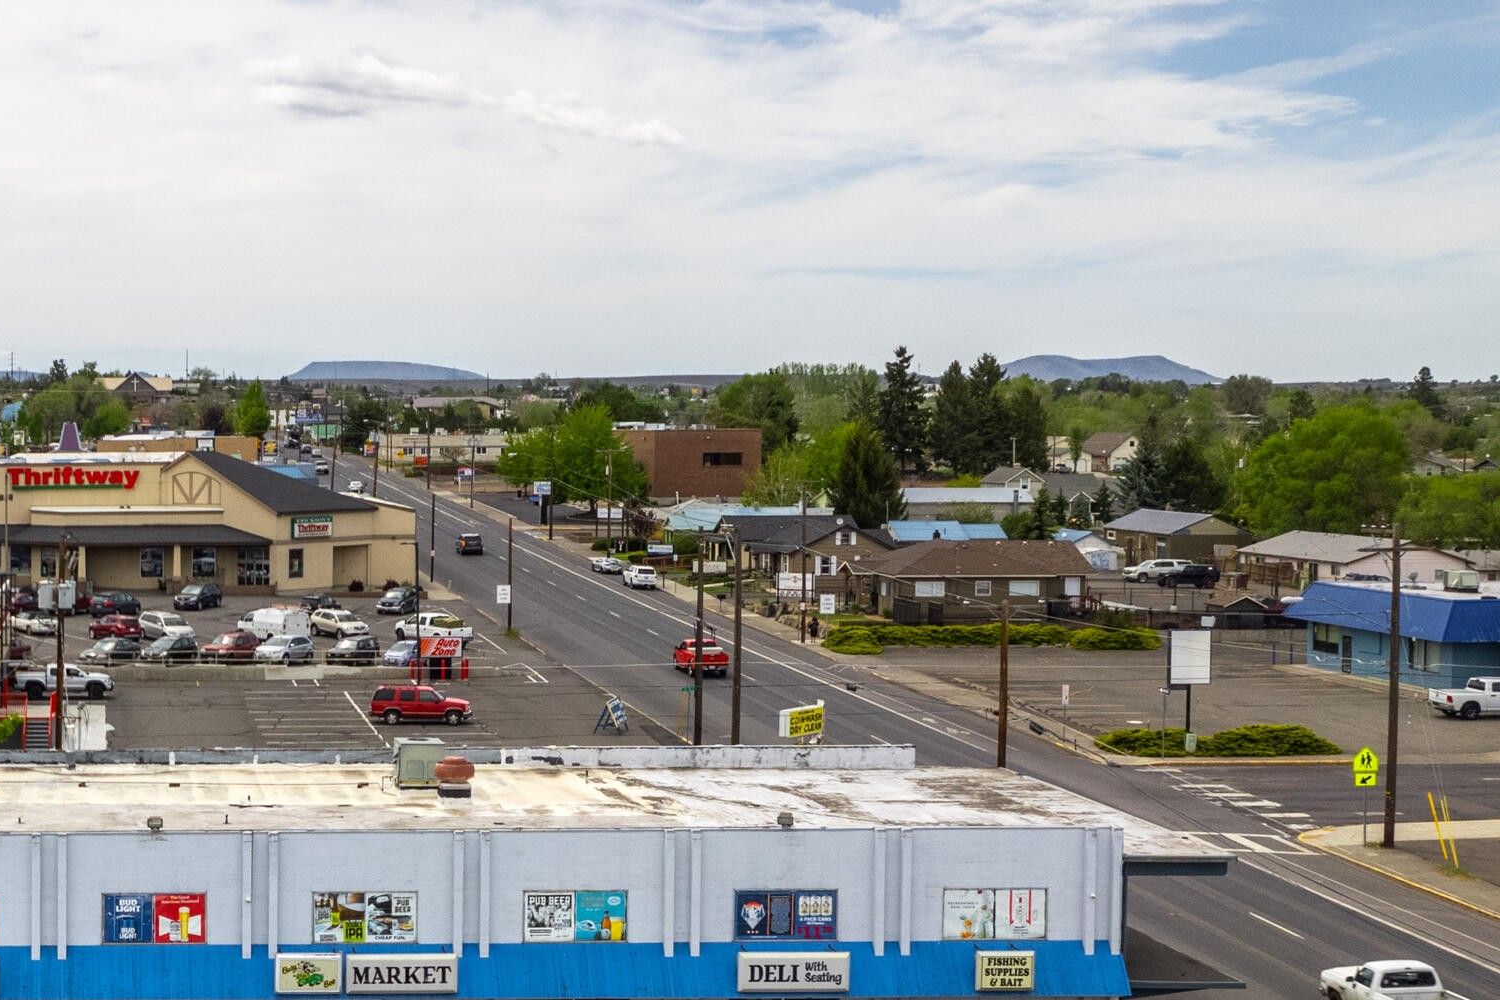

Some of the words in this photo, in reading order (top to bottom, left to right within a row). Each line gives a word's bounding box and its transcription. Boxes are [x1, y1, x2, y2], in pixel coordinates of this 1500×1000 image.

[7, 466, 140, 489] Thriftway
[297, 524, 329, 532] Thriftway
[436, 638, 460, 648] Auto
[431, 646, 457, 656] Zone
[790, 725, 802, 736] DRY
[803, 721, 822, 732] CLEAN
[529, 896, 547, 906] PUB
[548, 896, 571, 906] BEER
[115, 905, 141, 913] LIGHT
[345, 928, 363, 939] IPA
[804, 961, 828, 972] With
[987, 957, 1027, 966] FISHING
[352, 966, 451, 984] MARKET
[748, 964, 799, 983] DELI
[984, 968, 1030, 977] SUPPLIES
[804, 973, 842, 985] Seating
[989, 978, 998, 987] &
[1000, 978, 1023, 987] BAIT
